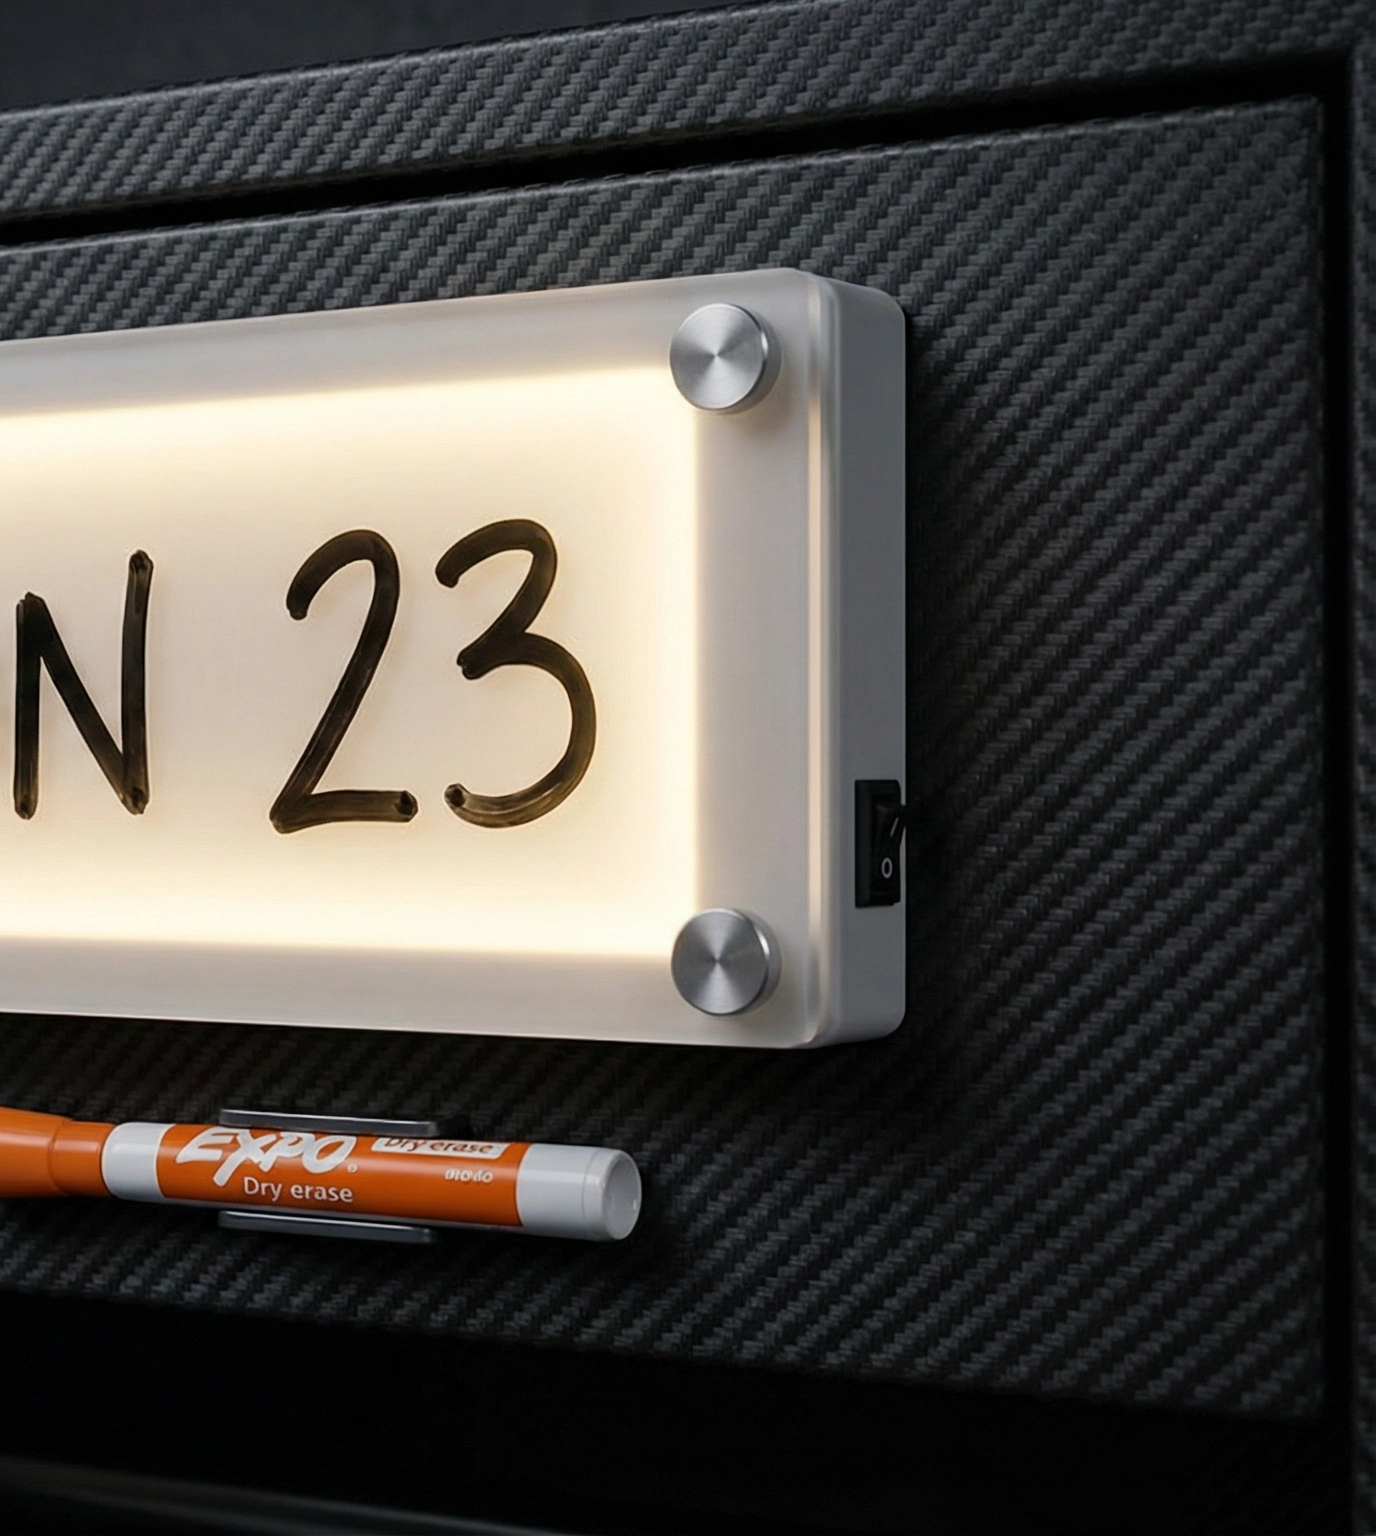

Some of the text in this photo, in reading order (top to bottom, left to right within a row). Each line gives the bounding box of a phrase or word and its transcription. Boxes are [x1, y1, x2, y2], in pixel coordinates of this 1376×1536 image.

[269, 518, 596, 833] 23
[429, 1141, 494, 1154] erase
[243, 1176, 354, 1203] Dry erase
